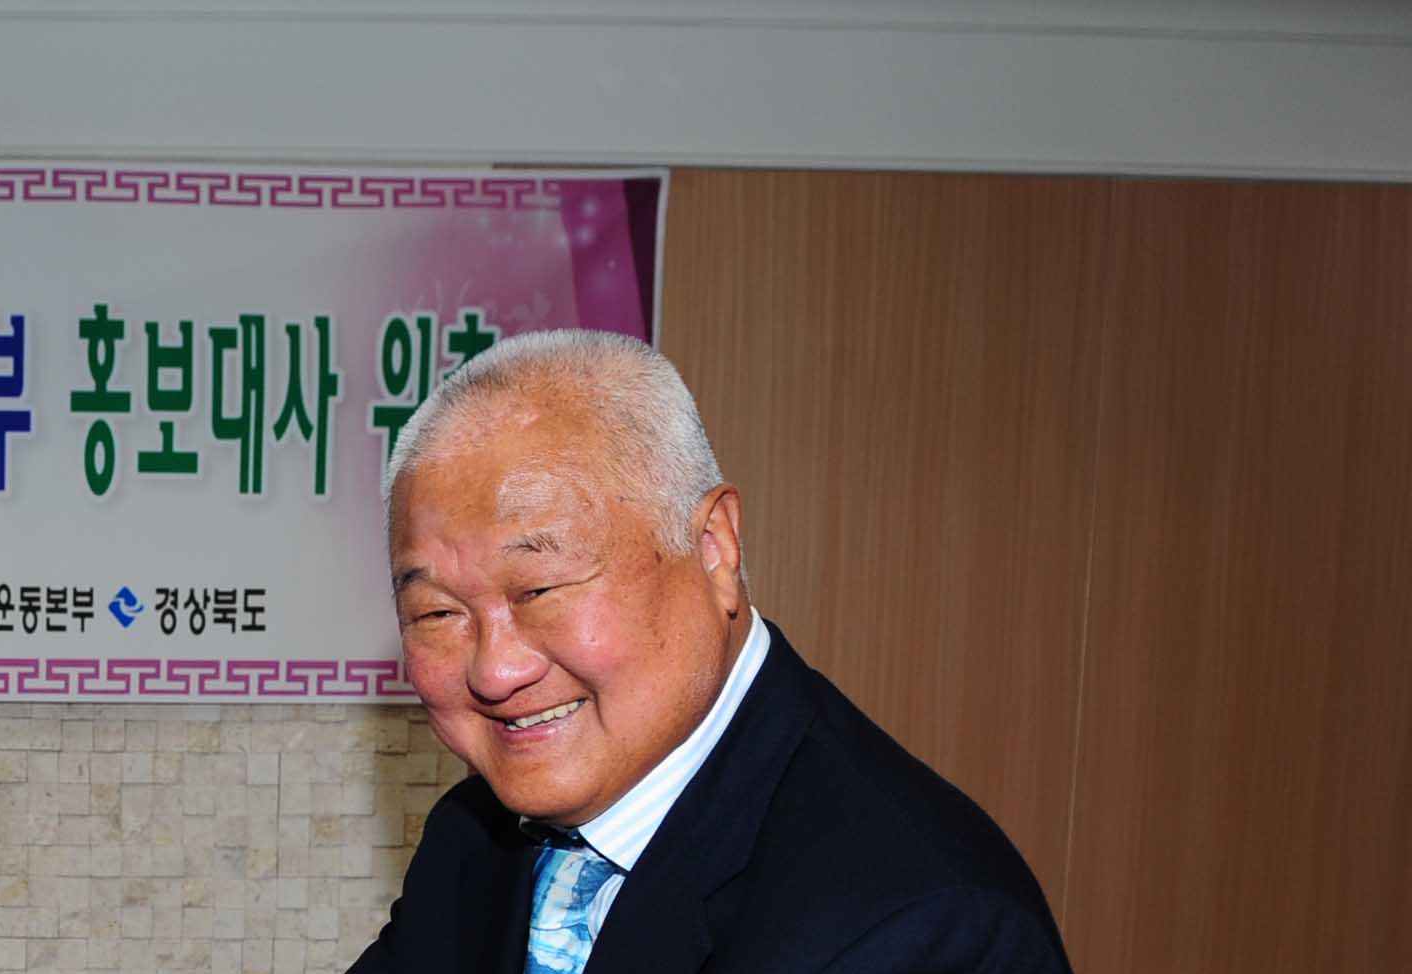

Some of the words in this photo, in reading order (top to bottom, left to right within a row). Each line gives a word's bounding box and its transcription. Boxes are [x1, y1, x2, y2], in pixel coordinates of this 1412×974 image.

[70, 303, 338, 496] 홍보대사
[373, 313, 495, 465] 위
[154, 586, 267, 637] 경상북도
